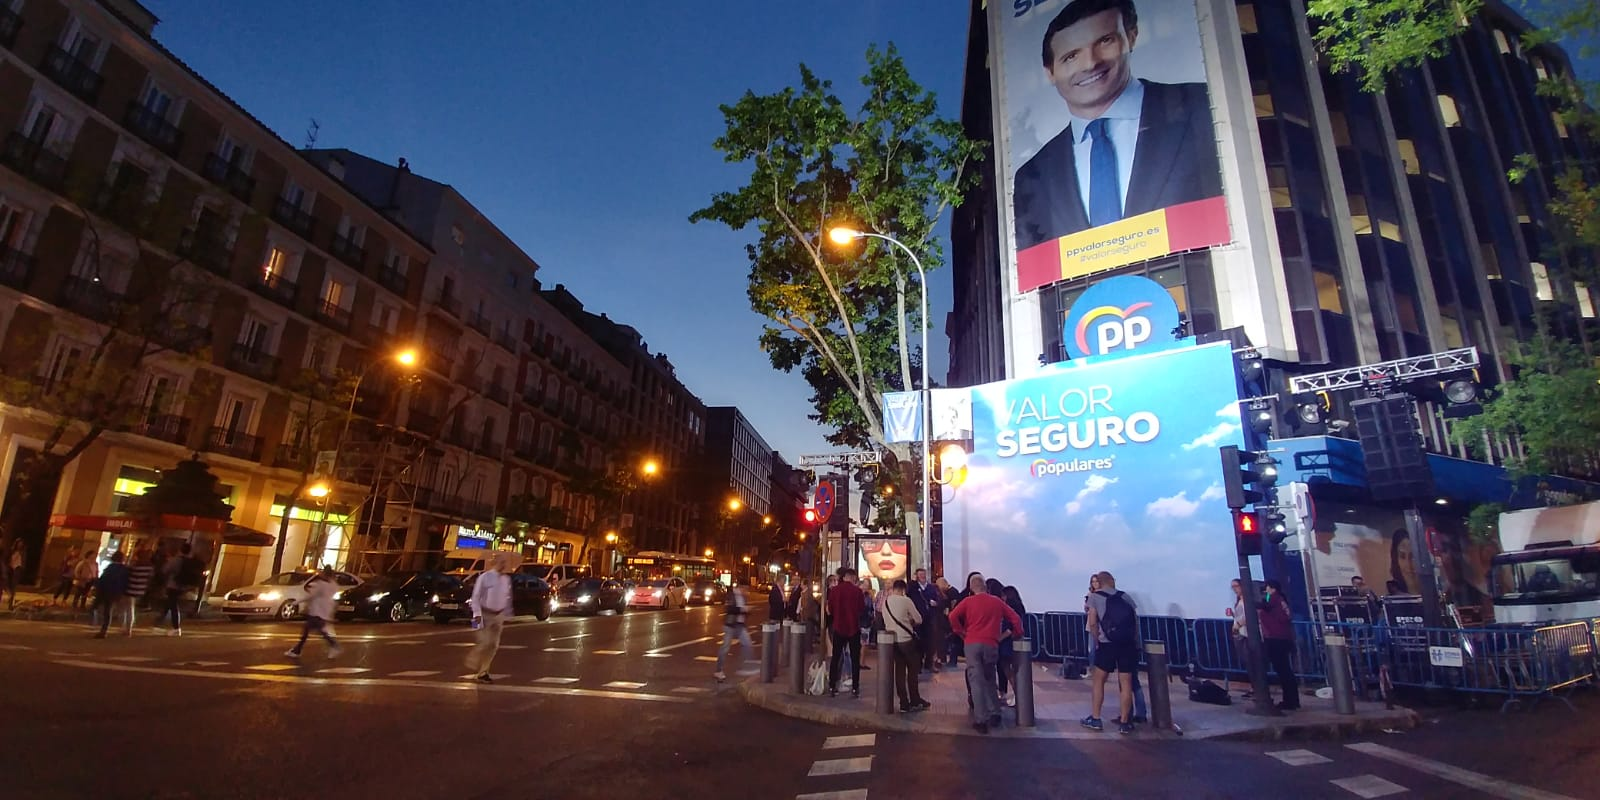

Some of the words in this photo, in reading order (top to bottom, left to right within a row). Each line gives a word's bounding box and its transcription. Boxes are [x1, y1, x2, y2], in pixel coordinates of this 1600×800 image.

[1066, 226, 1160, 257] ppvalorseguro.es
[1080, 240, 1147, 263] #valorseguro
[1000, 384, 1114, 426] VALOR
[996, 410, 1160, 457] SEGURO
[1037, 457, 1112, 478] populares
